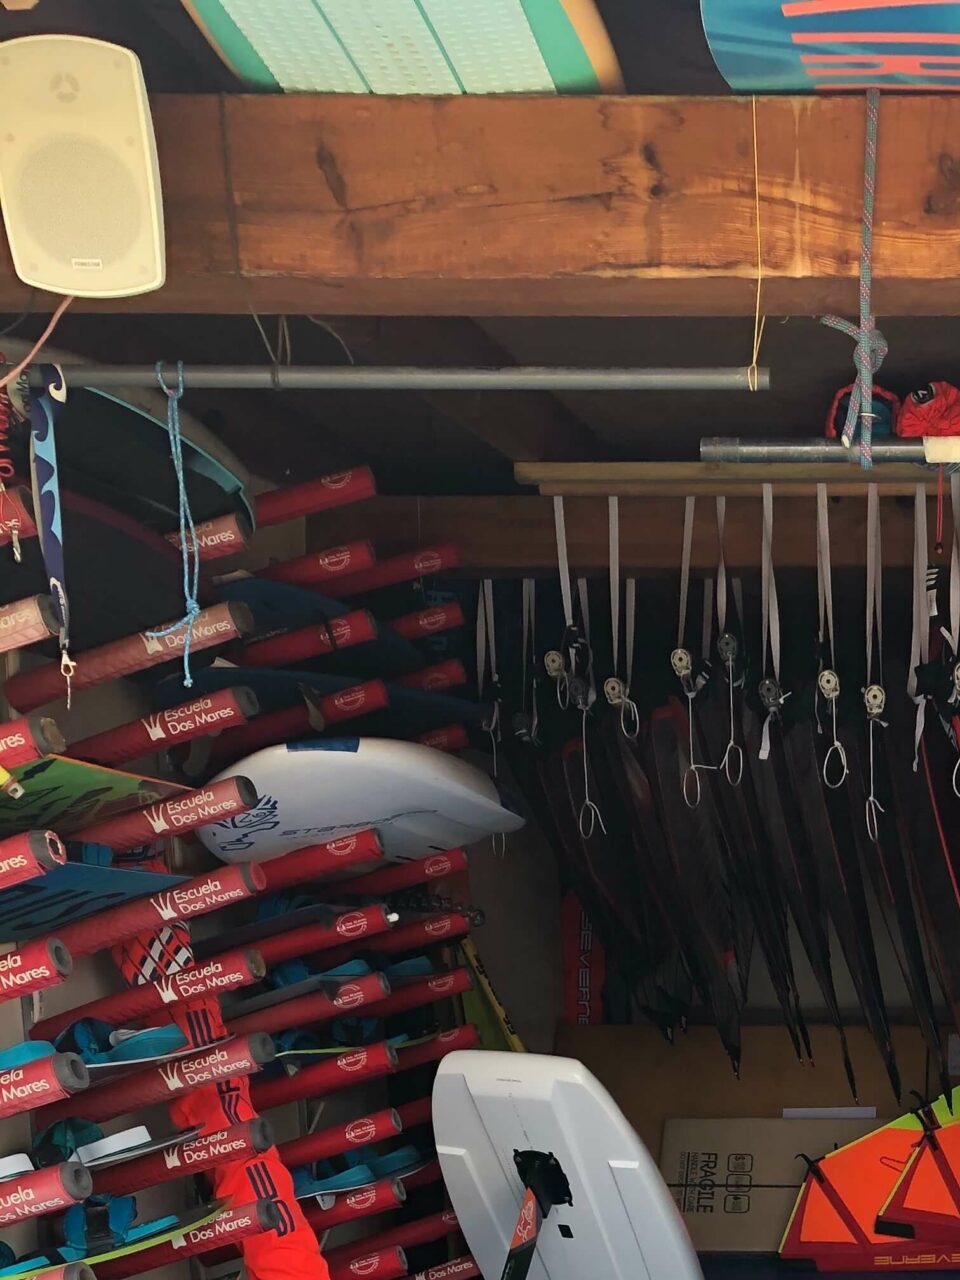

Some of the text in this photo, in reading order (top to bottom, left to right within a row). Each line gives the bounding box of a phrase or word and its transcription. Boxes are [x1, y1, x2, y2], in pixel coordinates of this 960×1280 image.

[198, 529, 235, 549] Mares
[0, 611, 33, 630] ares
[164, 699, 212, 721] Escuela
[167, 707, 234, 736] Dos Mares
[0, 732, 25, 750] res
[166, 790, 215, 813] Escuela
[171, 798, 237, 827] Dos Mares
[0, 854, 27, 873] ares
[173, 879, 221, 904] Escuela
[179, 888, 243, 914] Dos Mares
[1, 964, 50, 990] Mares
[176, 961, 222, 984] Escuela
[179, 971, 243, 997] Dos Mares
[181, 1049, 228, 1073] Escuela
[185, 1057, 251, 1086] Dos Mares
[1, 1078, 50, 1102] Mares
[183, 1130, 228, 1150] Escuela
[184, 1138, 247, 1164] Dos Mares
[696, 1152, 718, 1213] FRAGILE
[0, 1187, 35, 1209] uela
[17, 1197, 64, 1217] Mares
[189, 1227, 214, 1243] Dos
[215, 1216, 251, 1236] Mares
[446, 1261, 473, 1277] Mares
